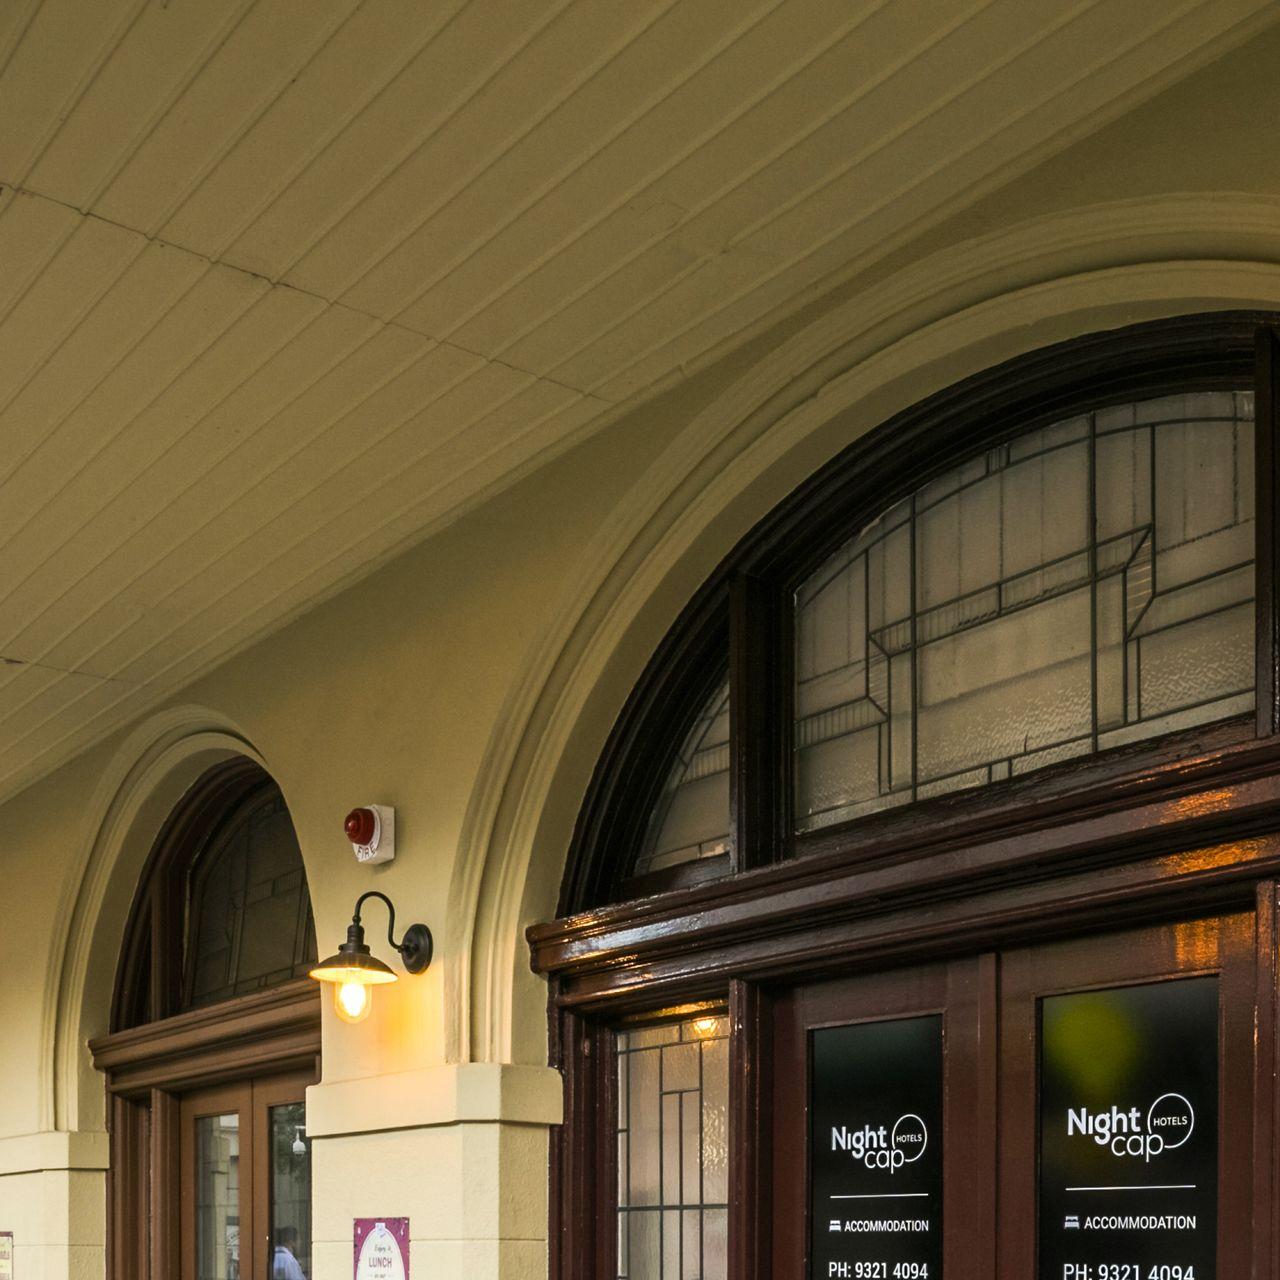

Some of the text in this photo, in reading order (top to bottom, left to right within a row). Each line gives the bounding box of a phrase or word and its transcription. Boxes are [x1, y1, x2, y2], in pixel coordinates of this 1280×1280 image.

[357, 841, 376, 859] FIRE
[1067, 1106, 1141, 1145] Night
[1153, 1116, 1188, 1127] HOTELS
[831, 1124, 888, 1159] Night
[896, 1133, 923, 1143] HOTELS
[1111, 1134, 1164, 1163] cap
[864, 1149, 905, 1174] cap
[844, 1219, 929, 1232] ACCOMMODATION
[1084, 1216, 1197, 1230] ACCOMMODATION
[369, 1257, 392, 1268] LUNCH
[828, 1261, 929, 1280] PH: 9321 4094
